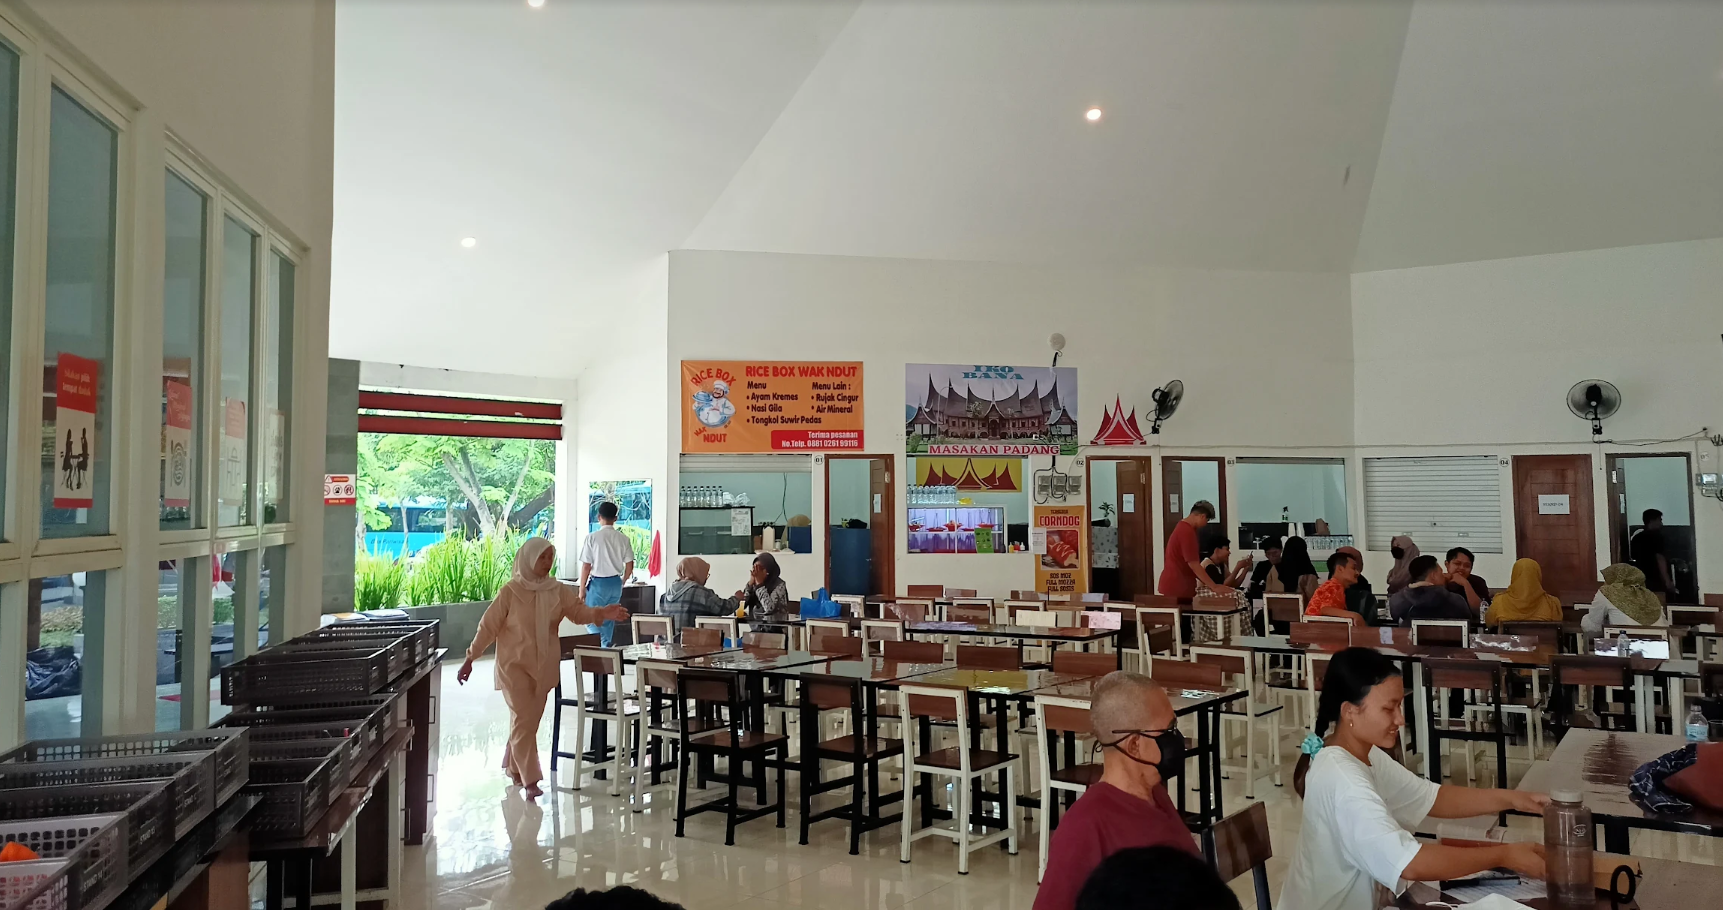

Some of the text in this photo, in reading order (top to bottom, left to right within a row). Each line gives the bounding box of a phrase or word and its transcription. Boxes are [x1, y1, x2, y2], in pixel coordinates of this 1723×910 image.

[746, 366, 857, 378] RICE BOX WAK NDUT
[974, 365, 1014, 373] IKO
[690, 368, 736, 386] RICE BOX
[962, 372, 1024, 380] BANA
[747, 381, 767, 389] Menu
[812, 382, 831, 390] Menu
[833, 381, 846, 390] Lain
[751, 392, 770, 402] Ayam
[816, 393, 859, 404] Rujak Cingur
[751, 404, 782, 412] Nasi Gila
[816, 405, 853, 413] Air Mineral
[751, 415, 822, 426] Tongkol Suwir Pedas
[703, 434, 727, 443] NDUT
[929, 445, 1060, 454] MASAKAN PADANG
[1040, 516, 1080, 526] CORNDOG
